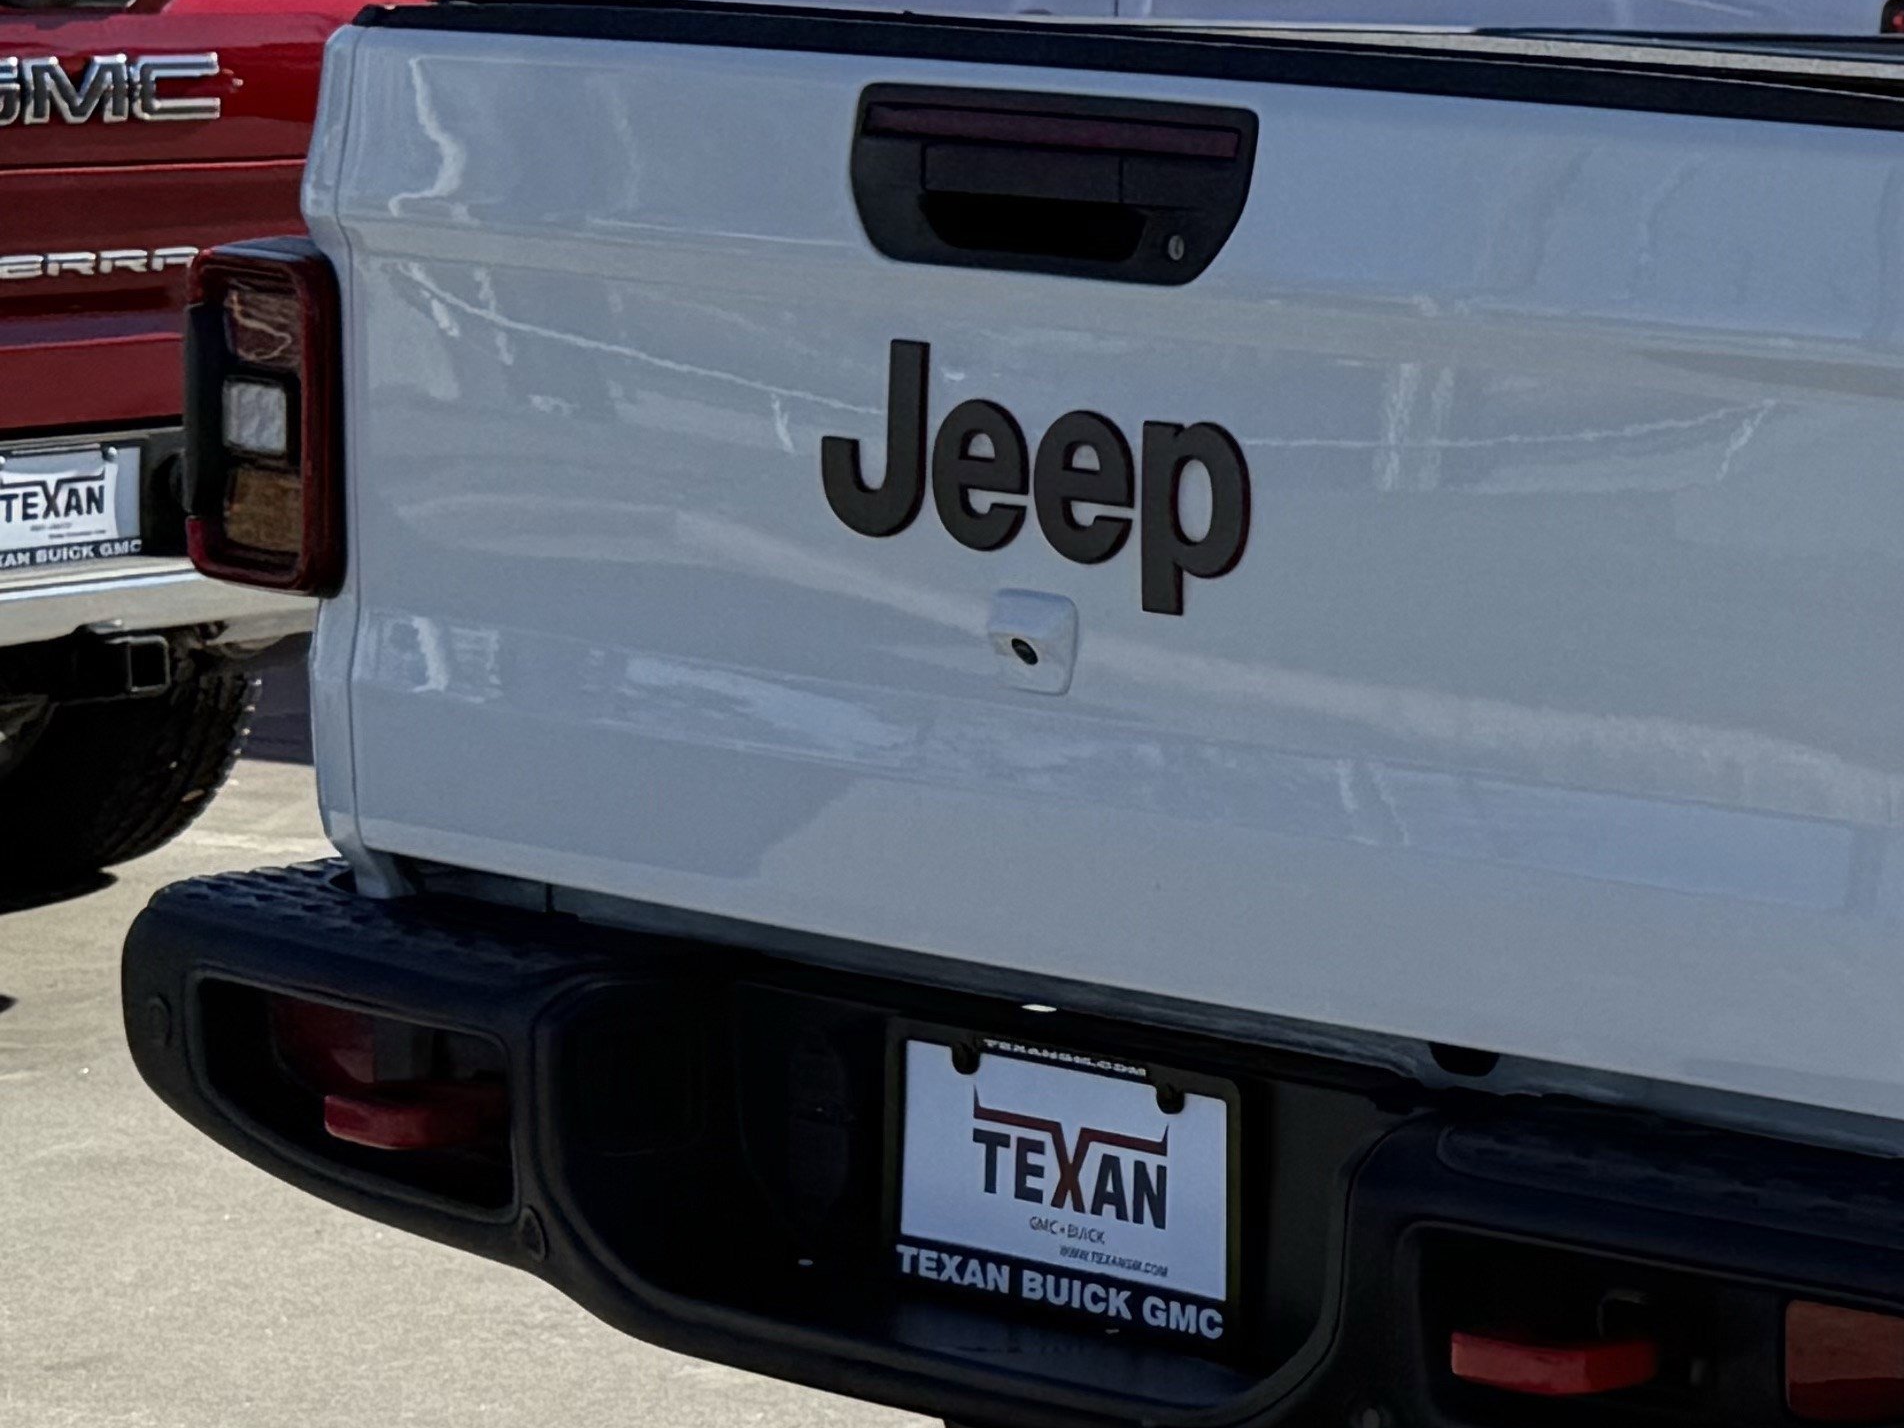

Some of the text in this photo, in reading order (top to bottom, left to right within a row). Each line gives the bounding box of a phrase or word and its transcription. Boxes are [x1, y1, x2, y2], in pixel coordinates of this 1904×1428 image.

[0, 52, 221, 126] MC
[0, 469, 105, 524] TEXAN
[821, 338, 1251, 616] Jeep
[35, 544, 95, 563] BUICK
[99, 538, 143, 557] GMC
[972, 1084, 1169, 1230] TEXAN
[896, 1244, 1224, 1340] TEXAN BUICK GMC
